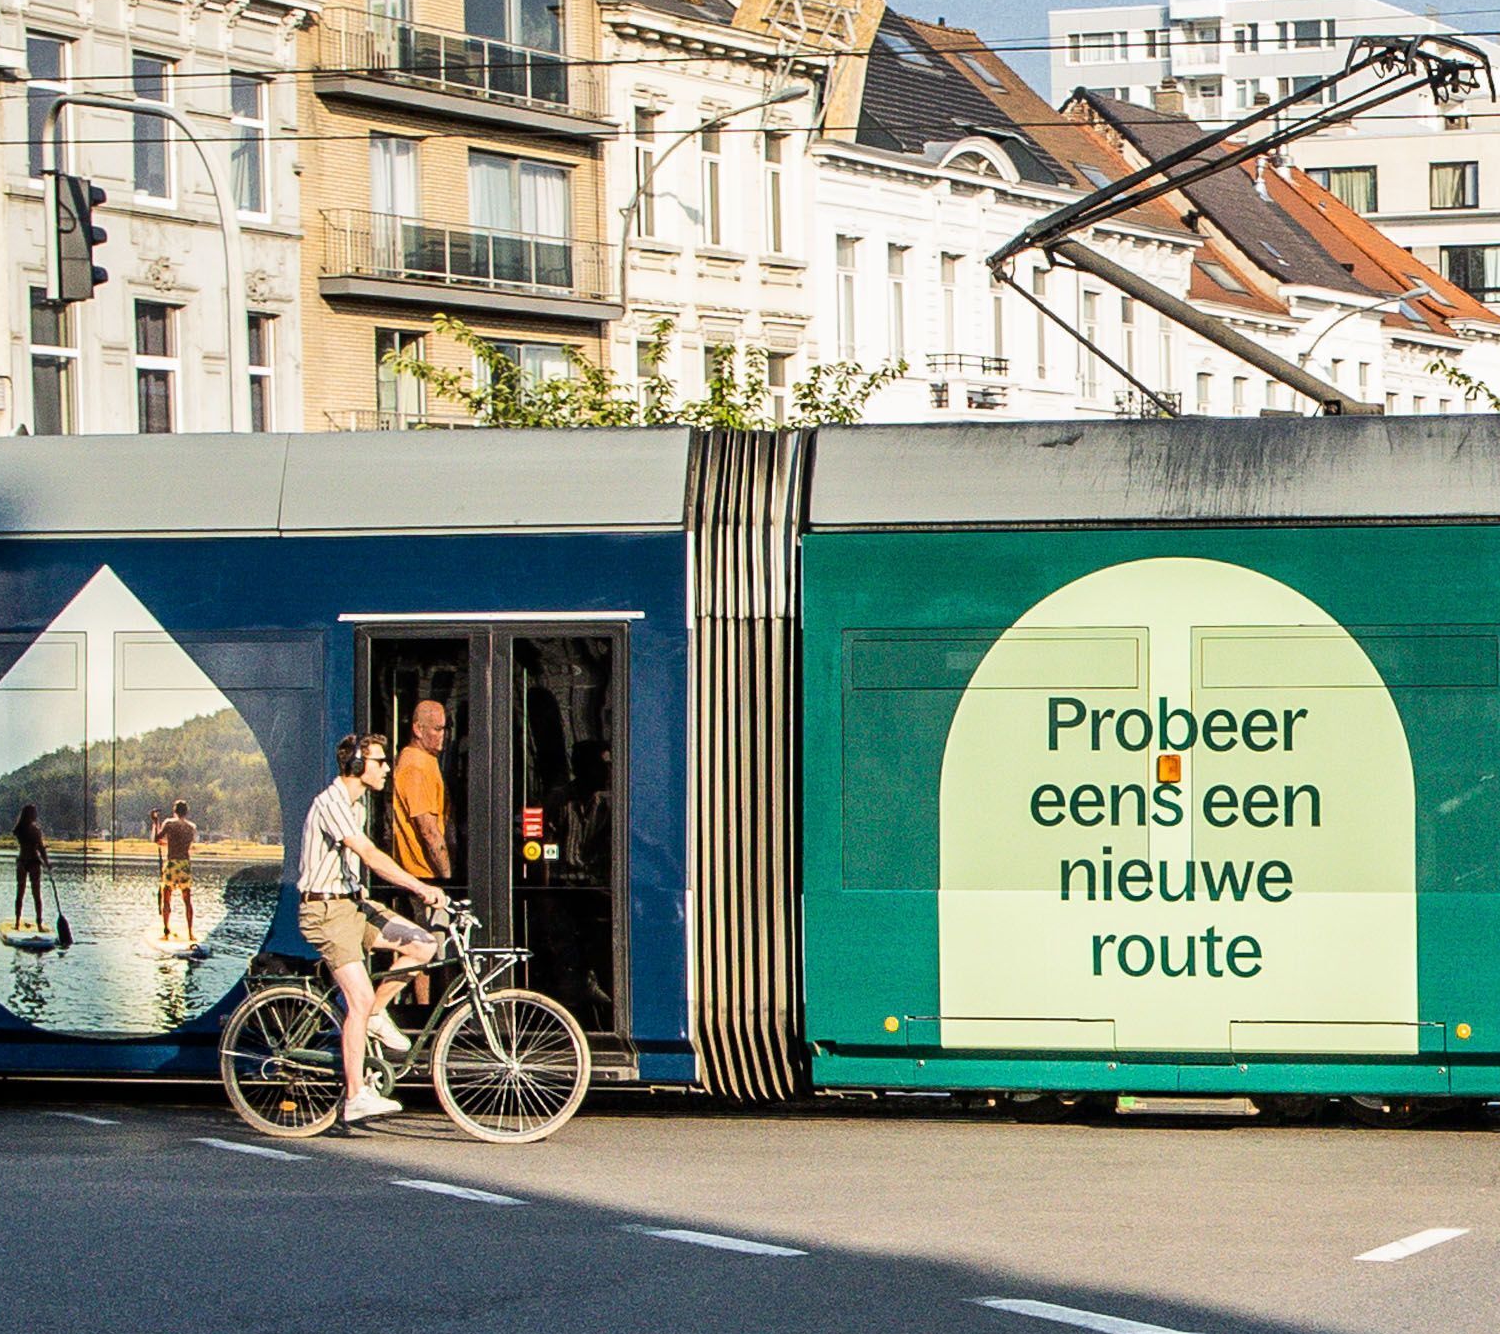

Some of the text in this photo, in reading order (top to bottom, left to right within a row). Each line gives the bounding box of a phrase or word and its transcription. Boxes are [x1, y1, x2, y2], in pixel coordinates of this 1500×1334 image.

[1047, 696, 1308, 752] Probeer
[1030, 783, 1321, 827] eens een
[1060, 847, 1293, 902] nieuwe
[1092, 925, 1264, 978] route
